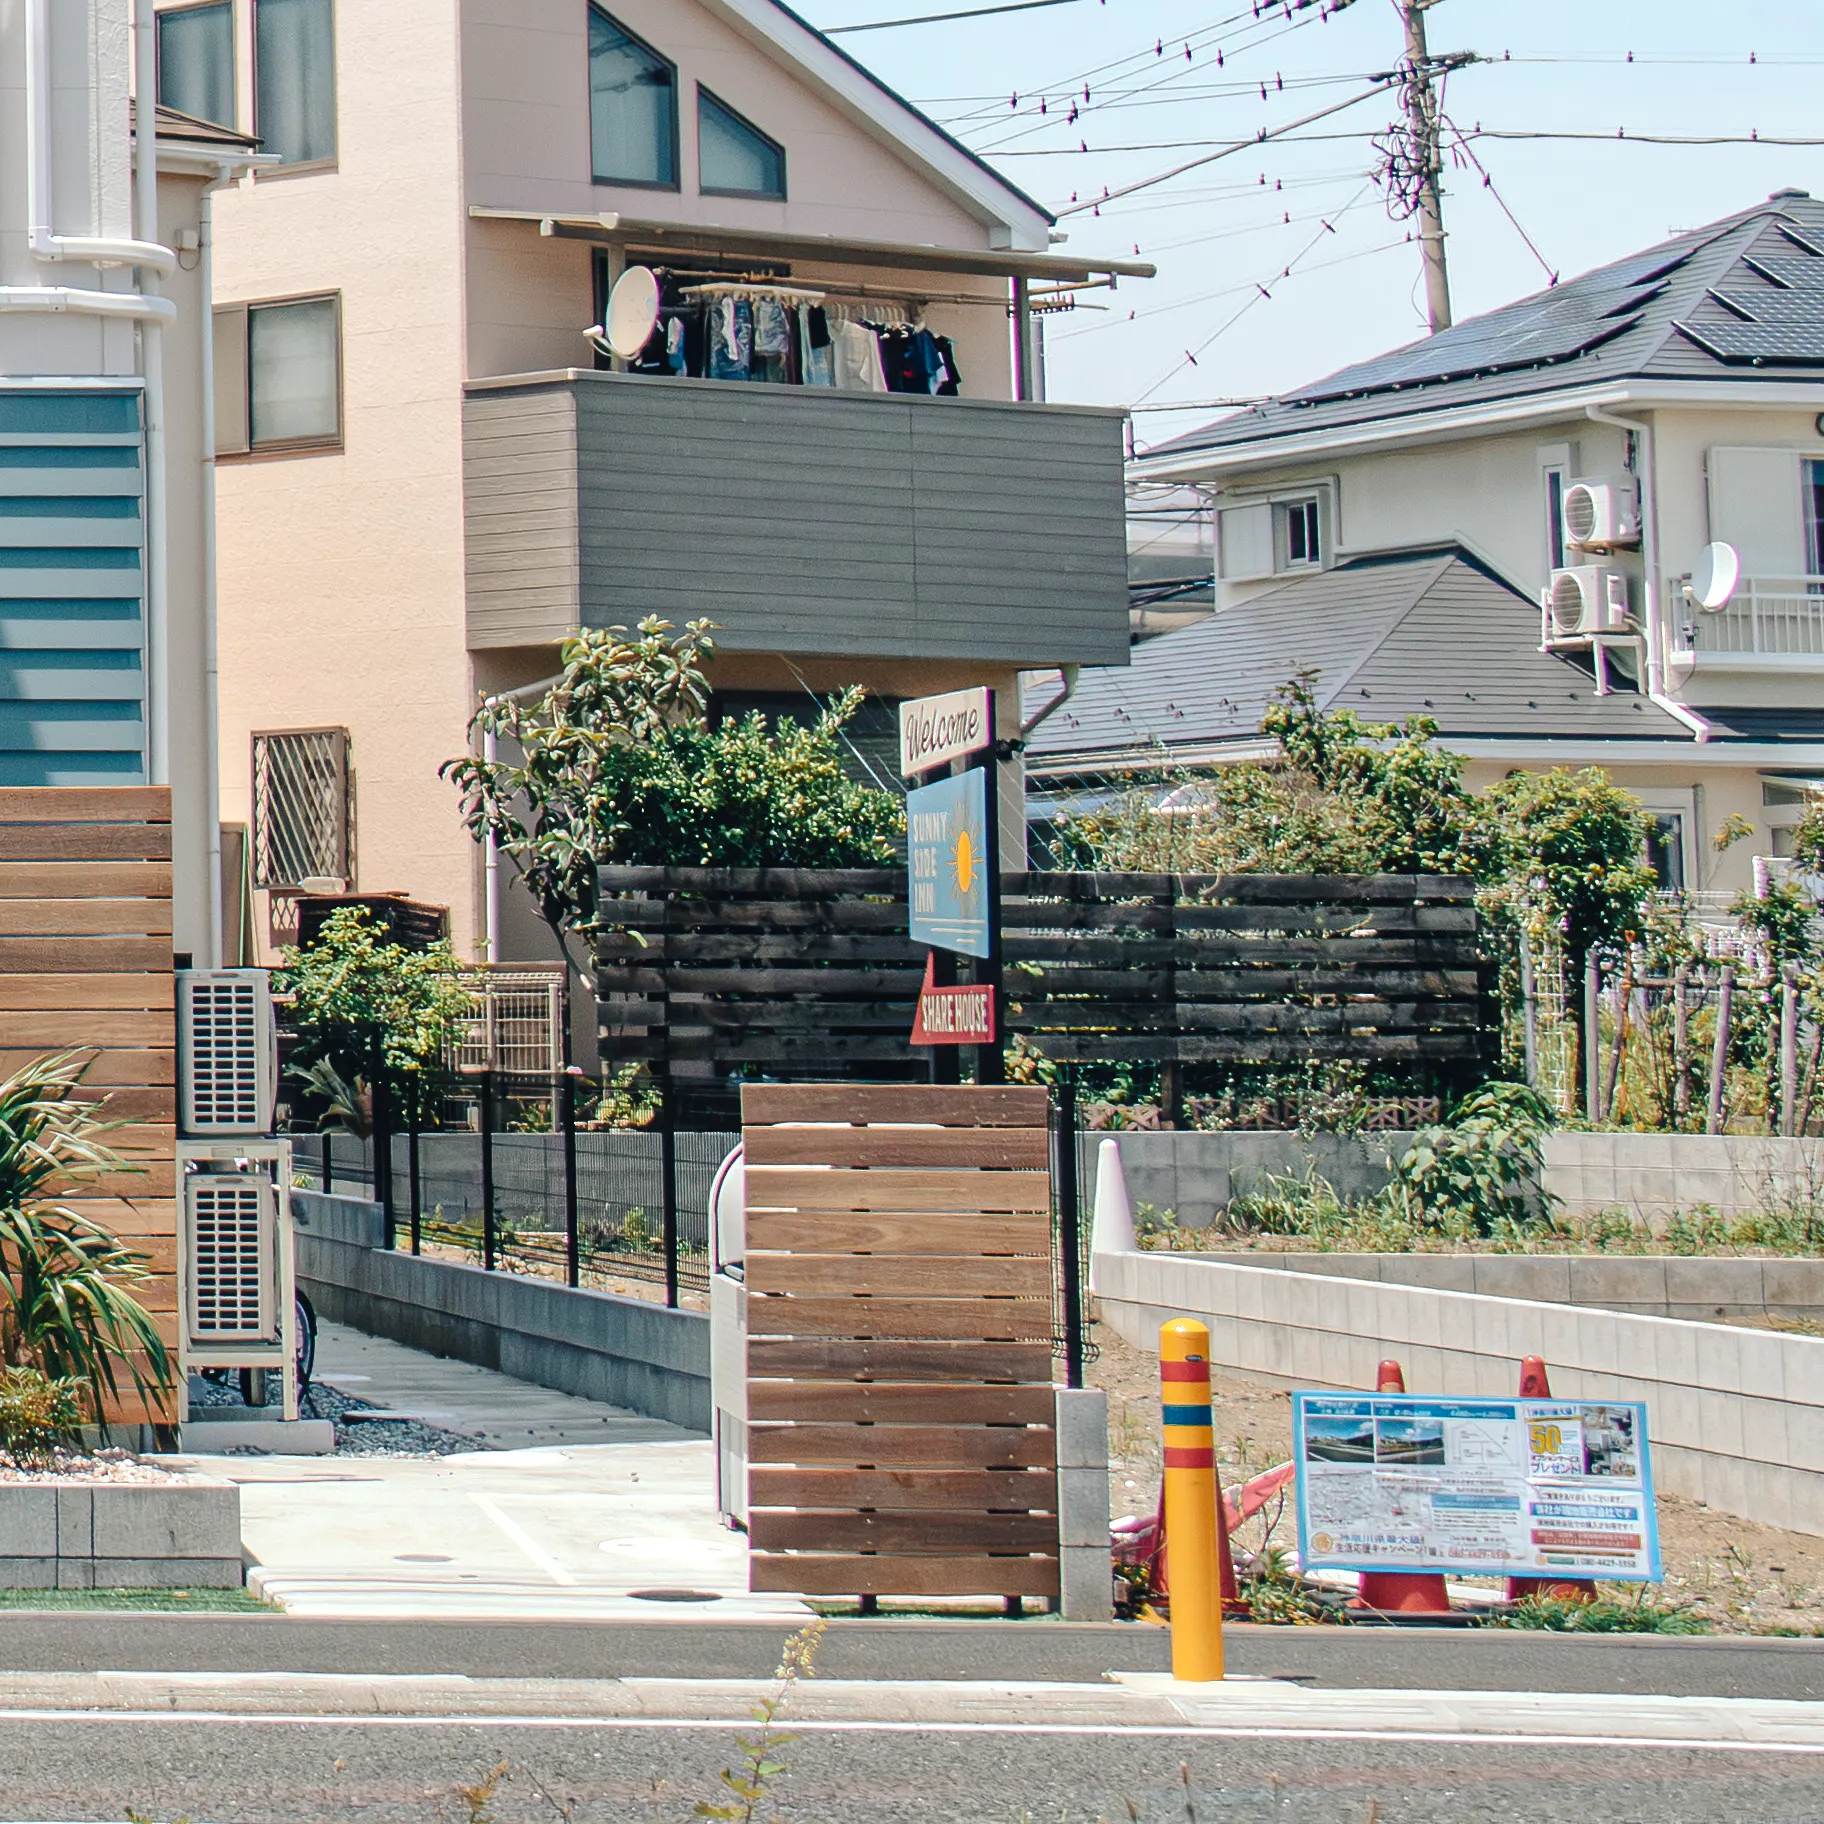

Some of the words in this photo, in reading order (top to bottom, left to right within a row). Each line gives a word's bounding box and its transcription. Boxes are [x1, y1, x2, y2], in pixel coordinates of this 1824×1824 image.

[906, 701, 979, 763] Welcome
[913, 811, 949, 843] SUNNY
[914, 847, 938, 878] SIDE
[914, 882, 935, 913] INN
